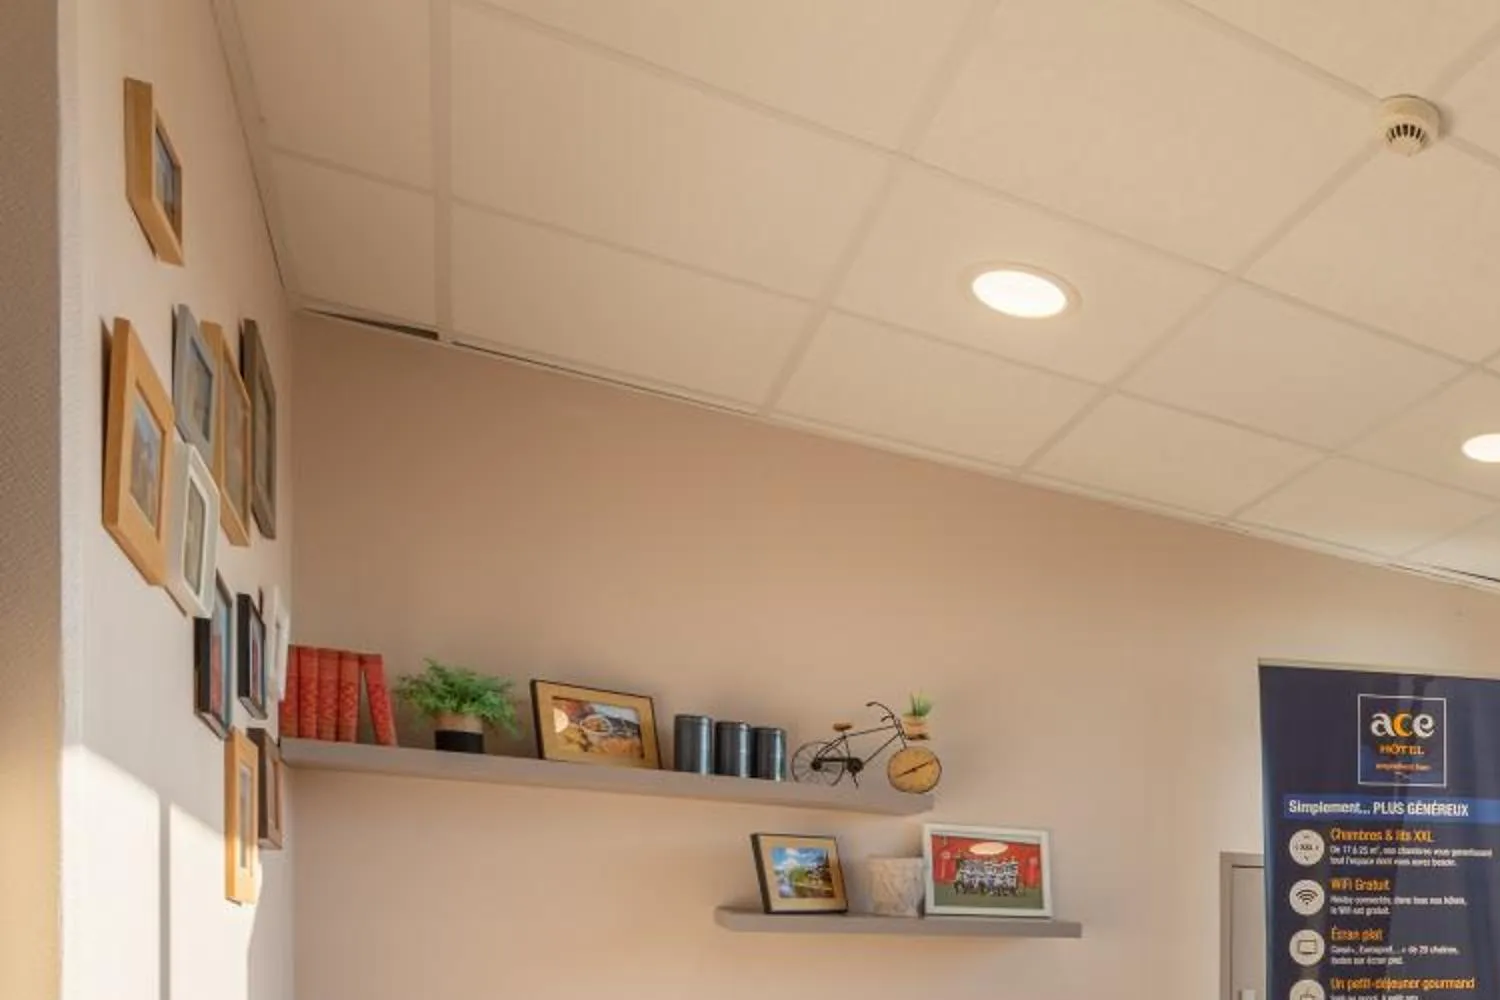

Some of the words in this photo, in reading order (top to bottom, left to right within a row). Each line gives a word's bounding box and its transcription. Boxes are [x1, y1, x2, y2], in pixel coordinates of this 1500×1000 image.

[1370, 712, 1435, 738] ace
[1289, 800, 1371, 817] Simplement...
[1373, 801, 1405, 815] PLUS
[1407, 801, 1469, 817] GÉNÉREUX
[1330, 828, 1383, 841] Chambres
[1385, 829, 1393, 841] &
[1413, 830, 1435, 842] XXL
[1355, 878, 1391, 891] Gratuit
[1331, 978, 1345, 990] Un
[1423, 978, 1475, 991] gourmand
